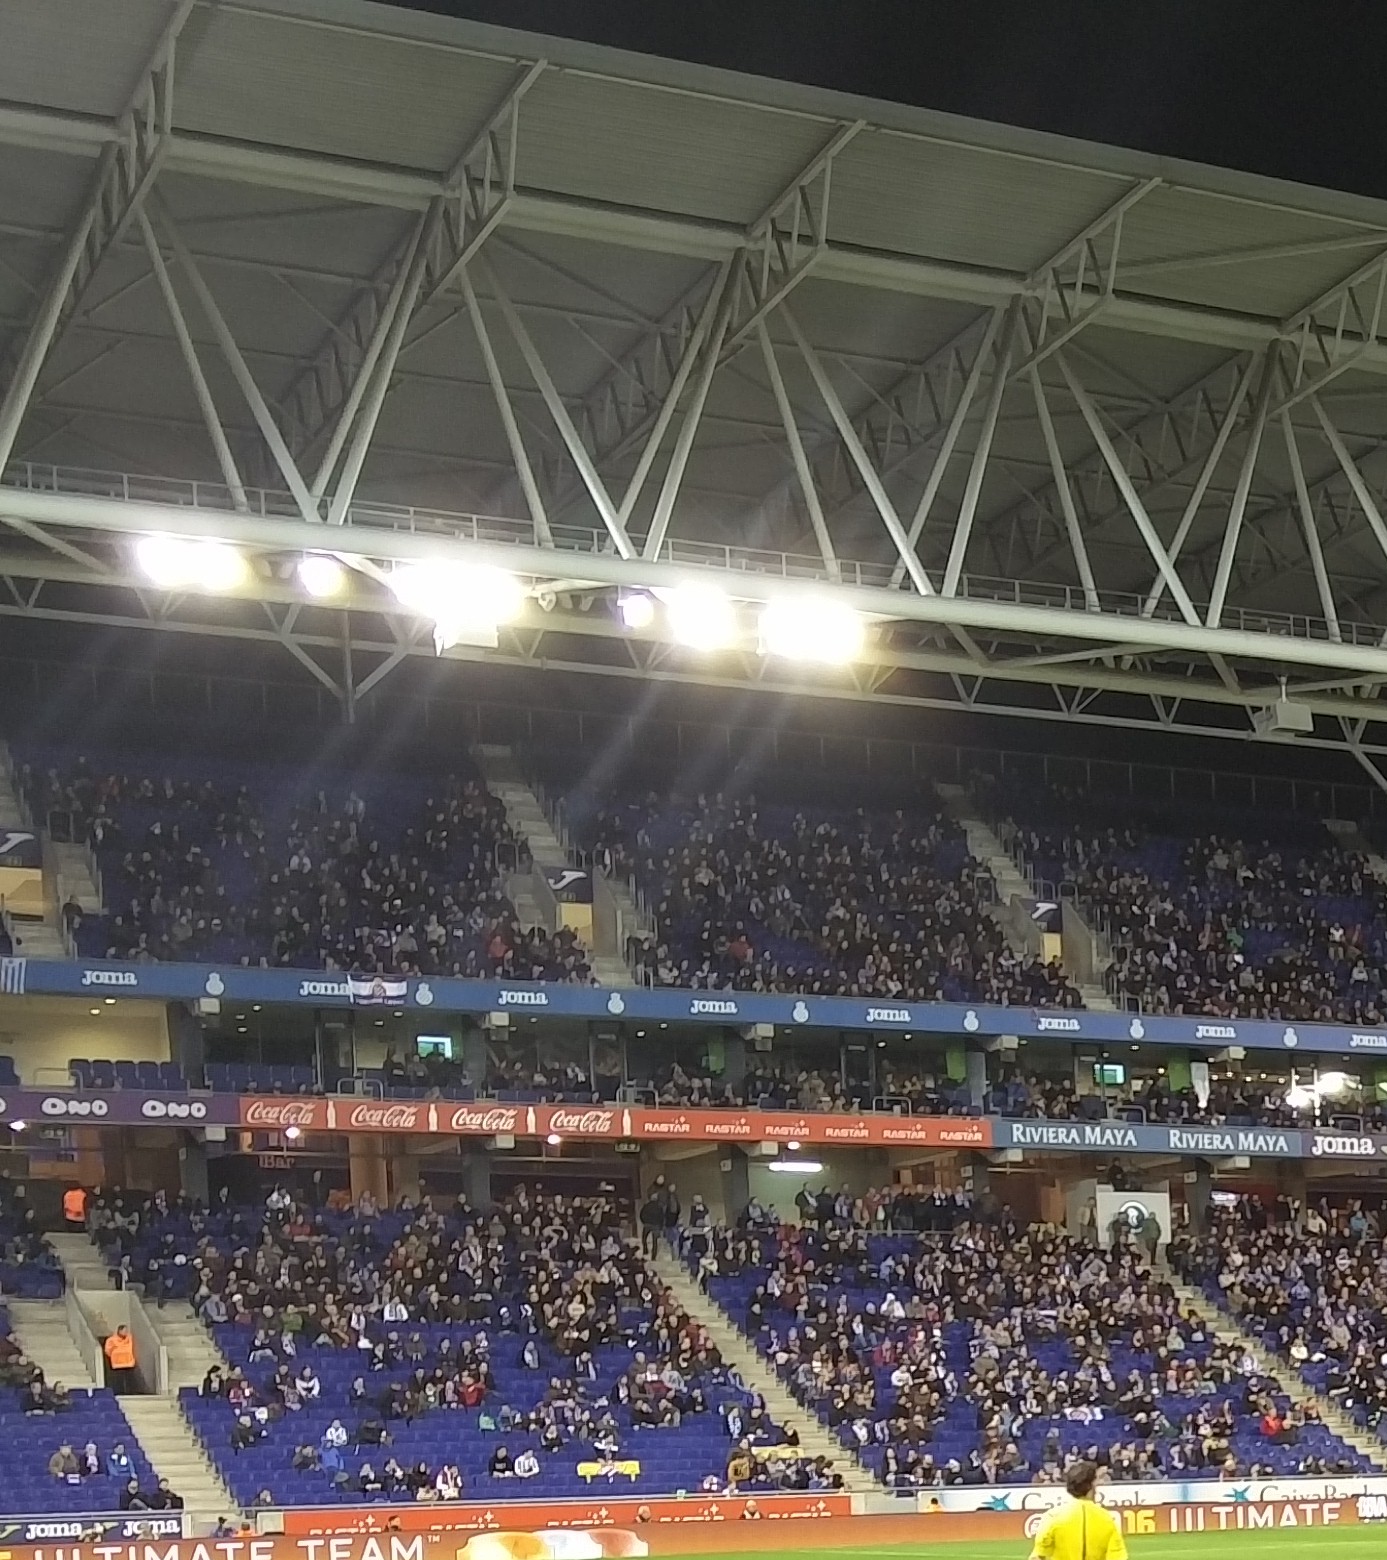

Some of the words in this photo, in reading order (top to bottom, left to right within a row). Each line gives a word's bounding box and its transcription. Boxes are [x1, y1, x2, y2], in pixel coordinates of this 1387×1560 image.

[41, 1097, 109, 1117] ONO
[141, 1099, 207, 1118] ONO
[1012, 1123, 1081, 1145] RIVIERA
[1084, 1125, 1138, 1147] MAYA
[1169, 1129, 1235, 1151] RIVIERA
[1238, 1132, 1289, 1153] MAYA
